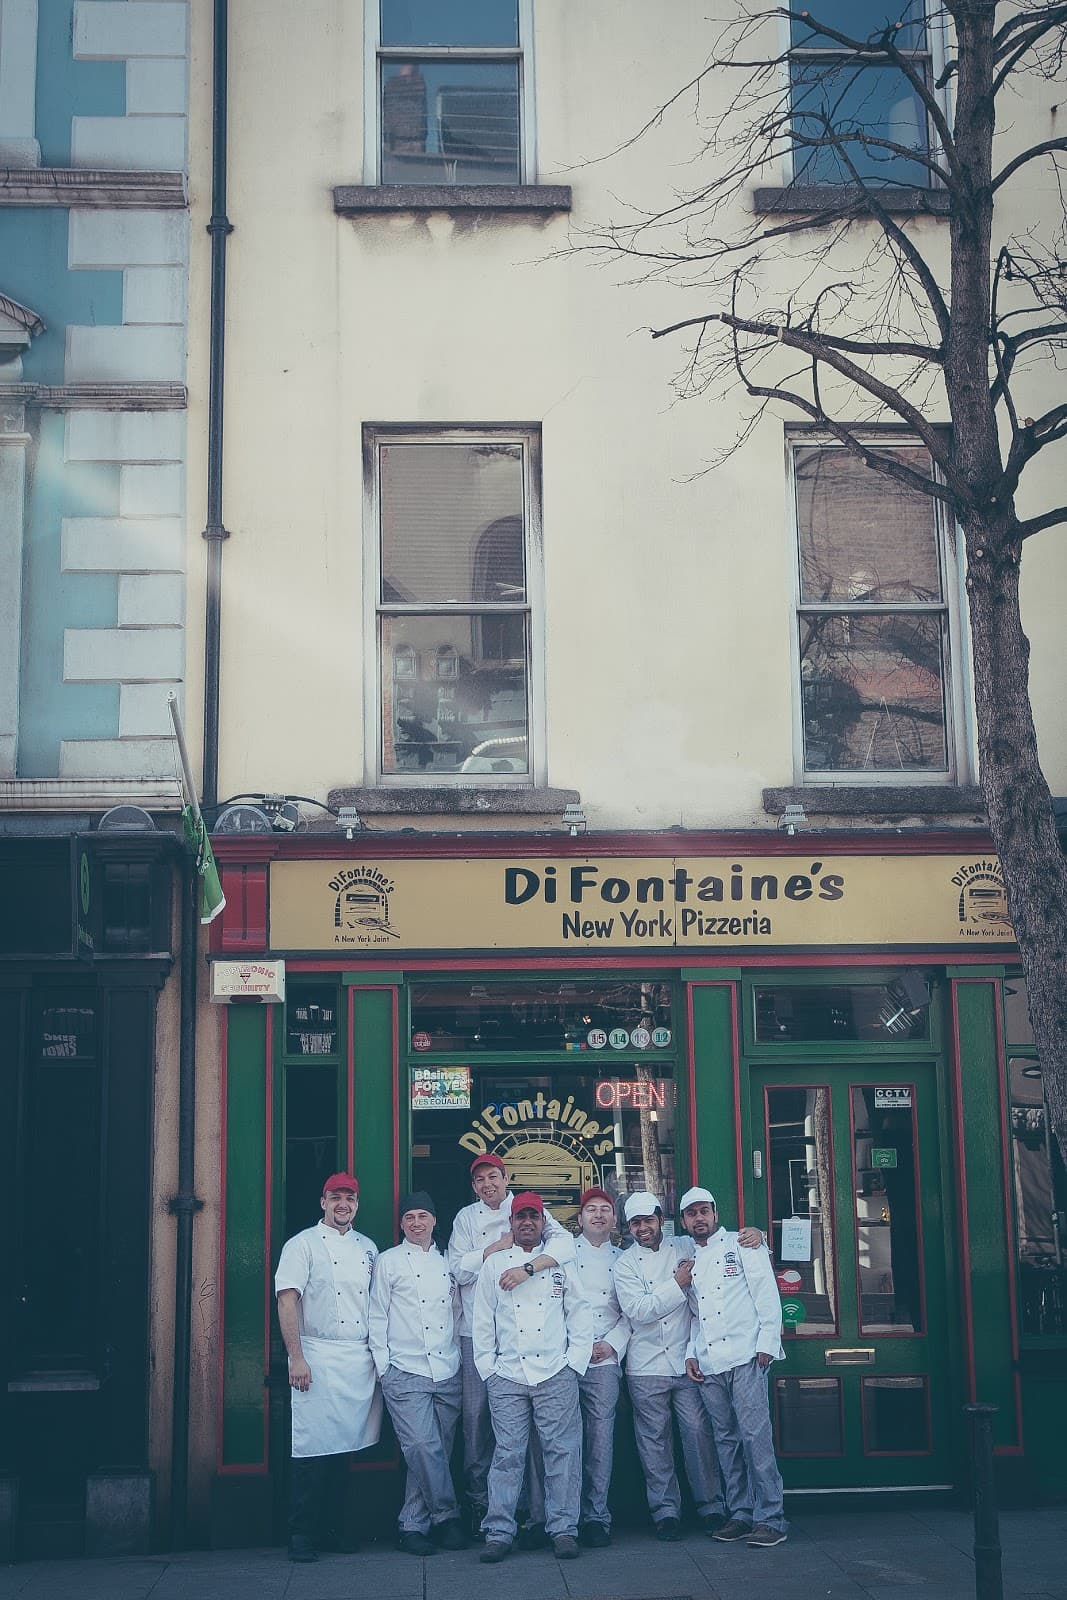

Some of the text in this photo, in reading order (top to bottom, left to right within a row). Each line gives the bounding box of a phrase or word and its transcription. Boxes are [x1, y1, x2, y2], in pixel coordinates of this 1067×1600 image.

[328, 866, 395, 894] DiFontaine's
[505, 862, 845, 905] DiFontaine's
[563, 908, 772, 939] New York Pizzeria
[959, 928, 965, 936] A
[966, 928, 980, 936] New
[981, 928, 995, 936] York
[334, 935, 390, 943] A New York Joint
[591, 1033, 605, 1045] 15
[613, 1033, 626, 1045] 14
[655, 1032, 669, 1043] 12
[414, 1080, 468, 1092] FOR YES
[596, 1081, 665, 1107] OPEN
[876, 1089, 910, 1097] CCTV
[458, 1092, 614, 1157] DiFontaine's
